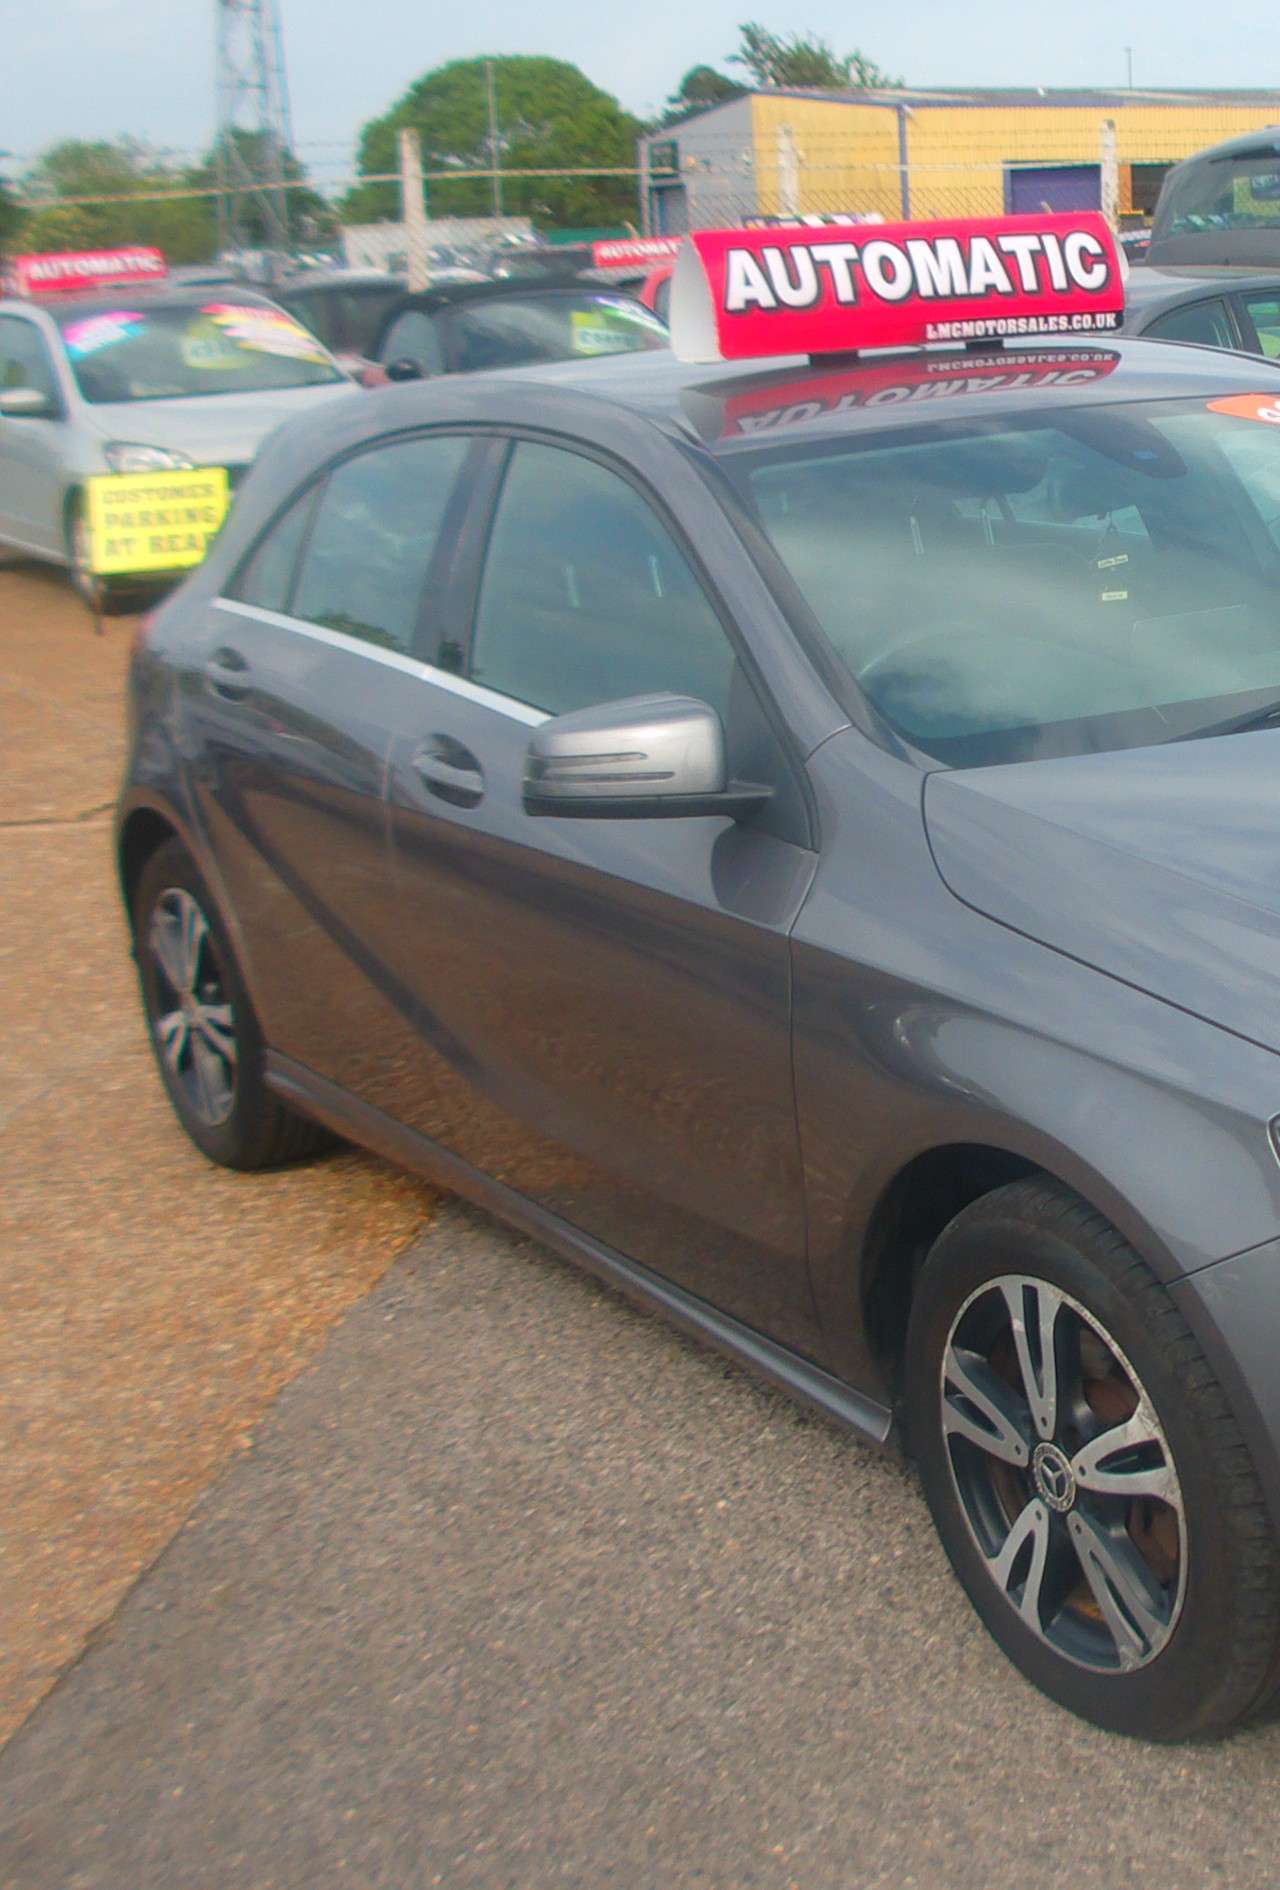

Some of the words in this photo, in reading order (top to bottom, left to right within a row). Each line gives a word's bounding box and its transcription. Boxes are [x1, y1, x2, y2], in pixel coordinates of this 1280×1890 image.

[27, 253, 163, 281] AUTOMATIC
[725, 231, 1110, 313] AUTOMATIC
[926, 312, 1117, 340] LMCMOTORSALES.CO.UK
[104, 506, 216, 529] PARKING
[105, 537, 136, 557] AT
[150, 533, 203, 554] REA
